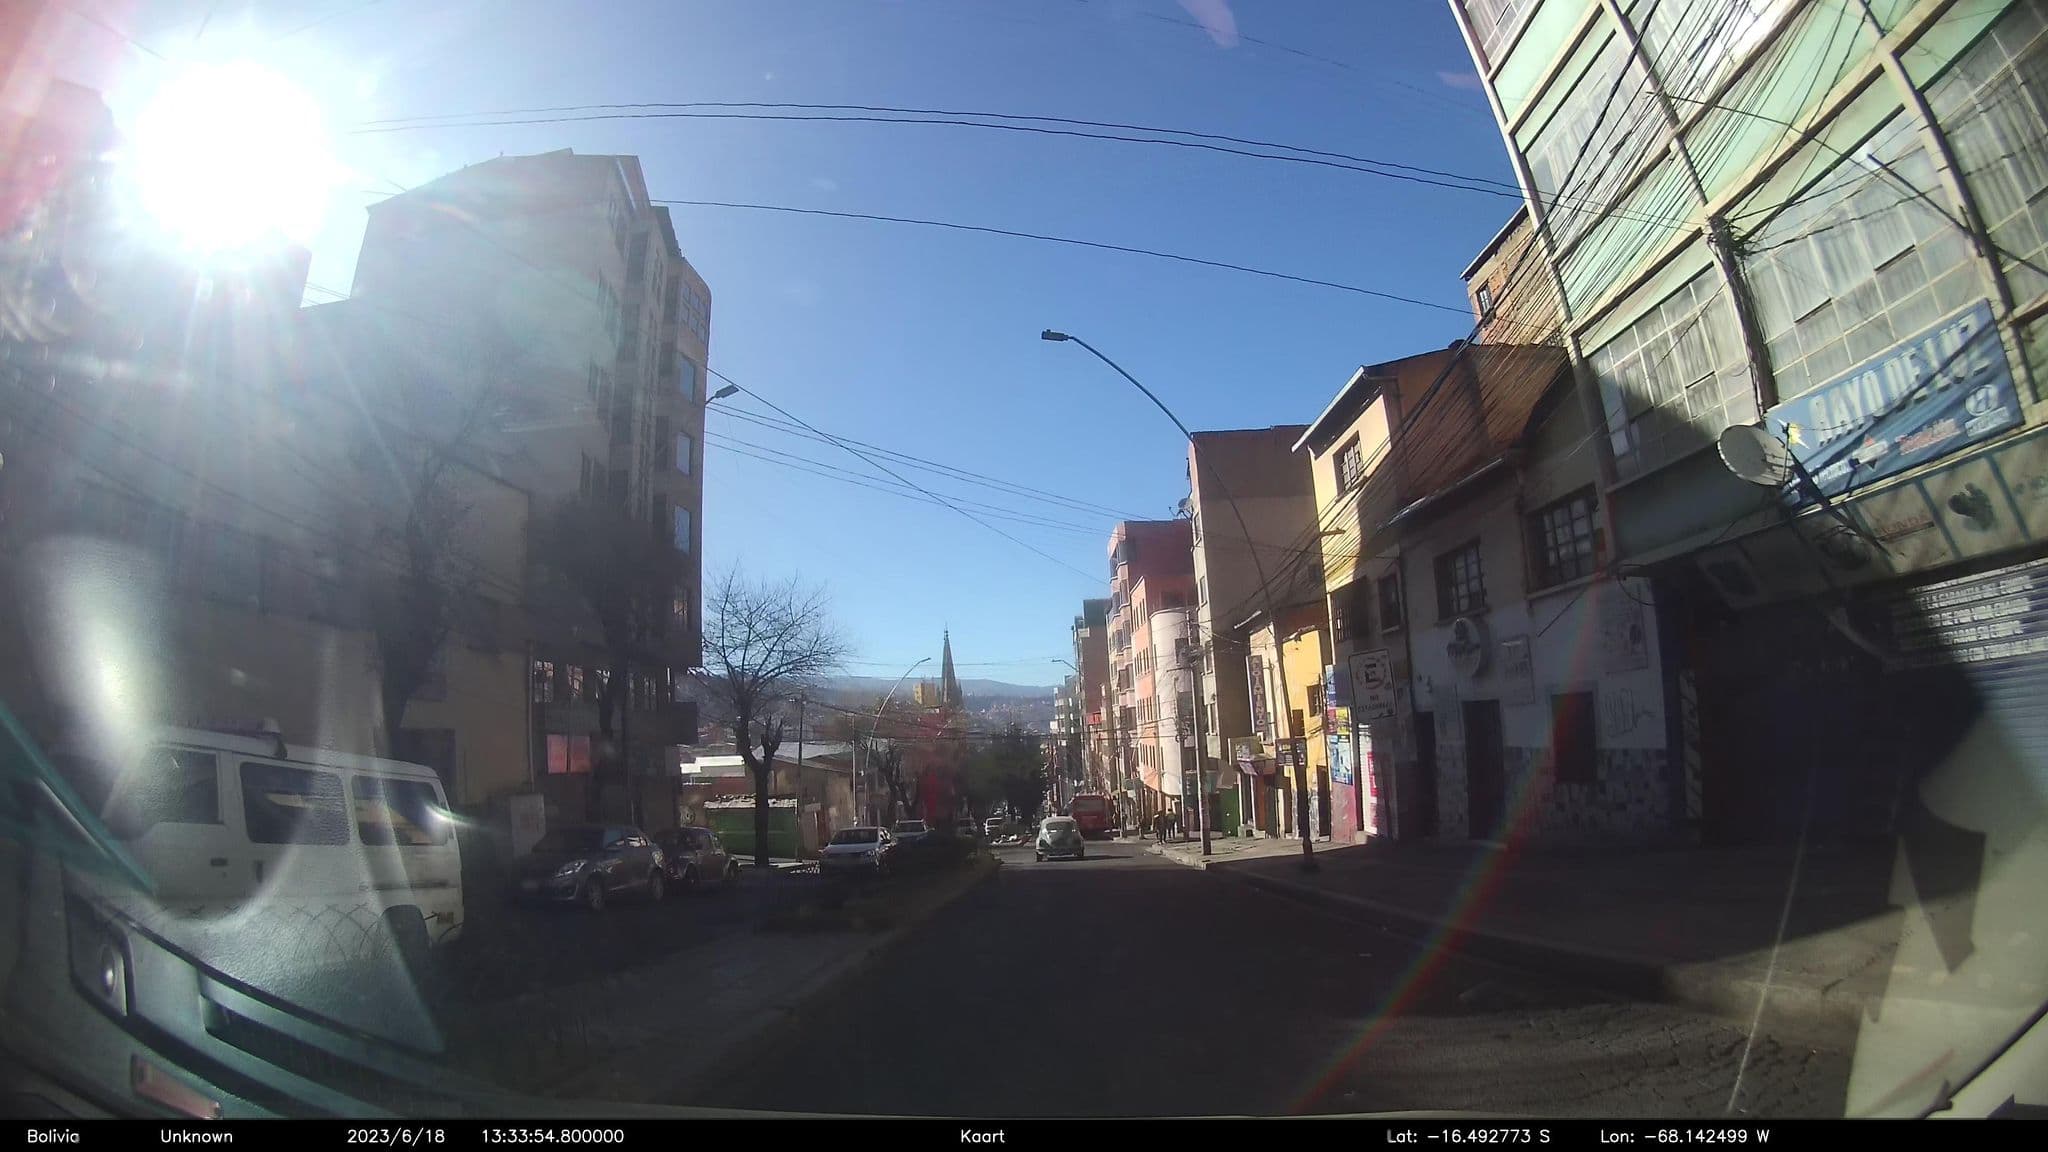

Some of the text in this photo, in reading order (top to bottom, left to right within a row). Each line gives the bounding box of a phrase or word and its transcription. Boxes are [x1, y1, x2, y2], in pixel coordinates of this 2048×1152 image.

[1810, 369, 1887, 447] RAYO
[1883, 347, 1928, 413] DE
[1924, 313, 1991, 391] LUZ
